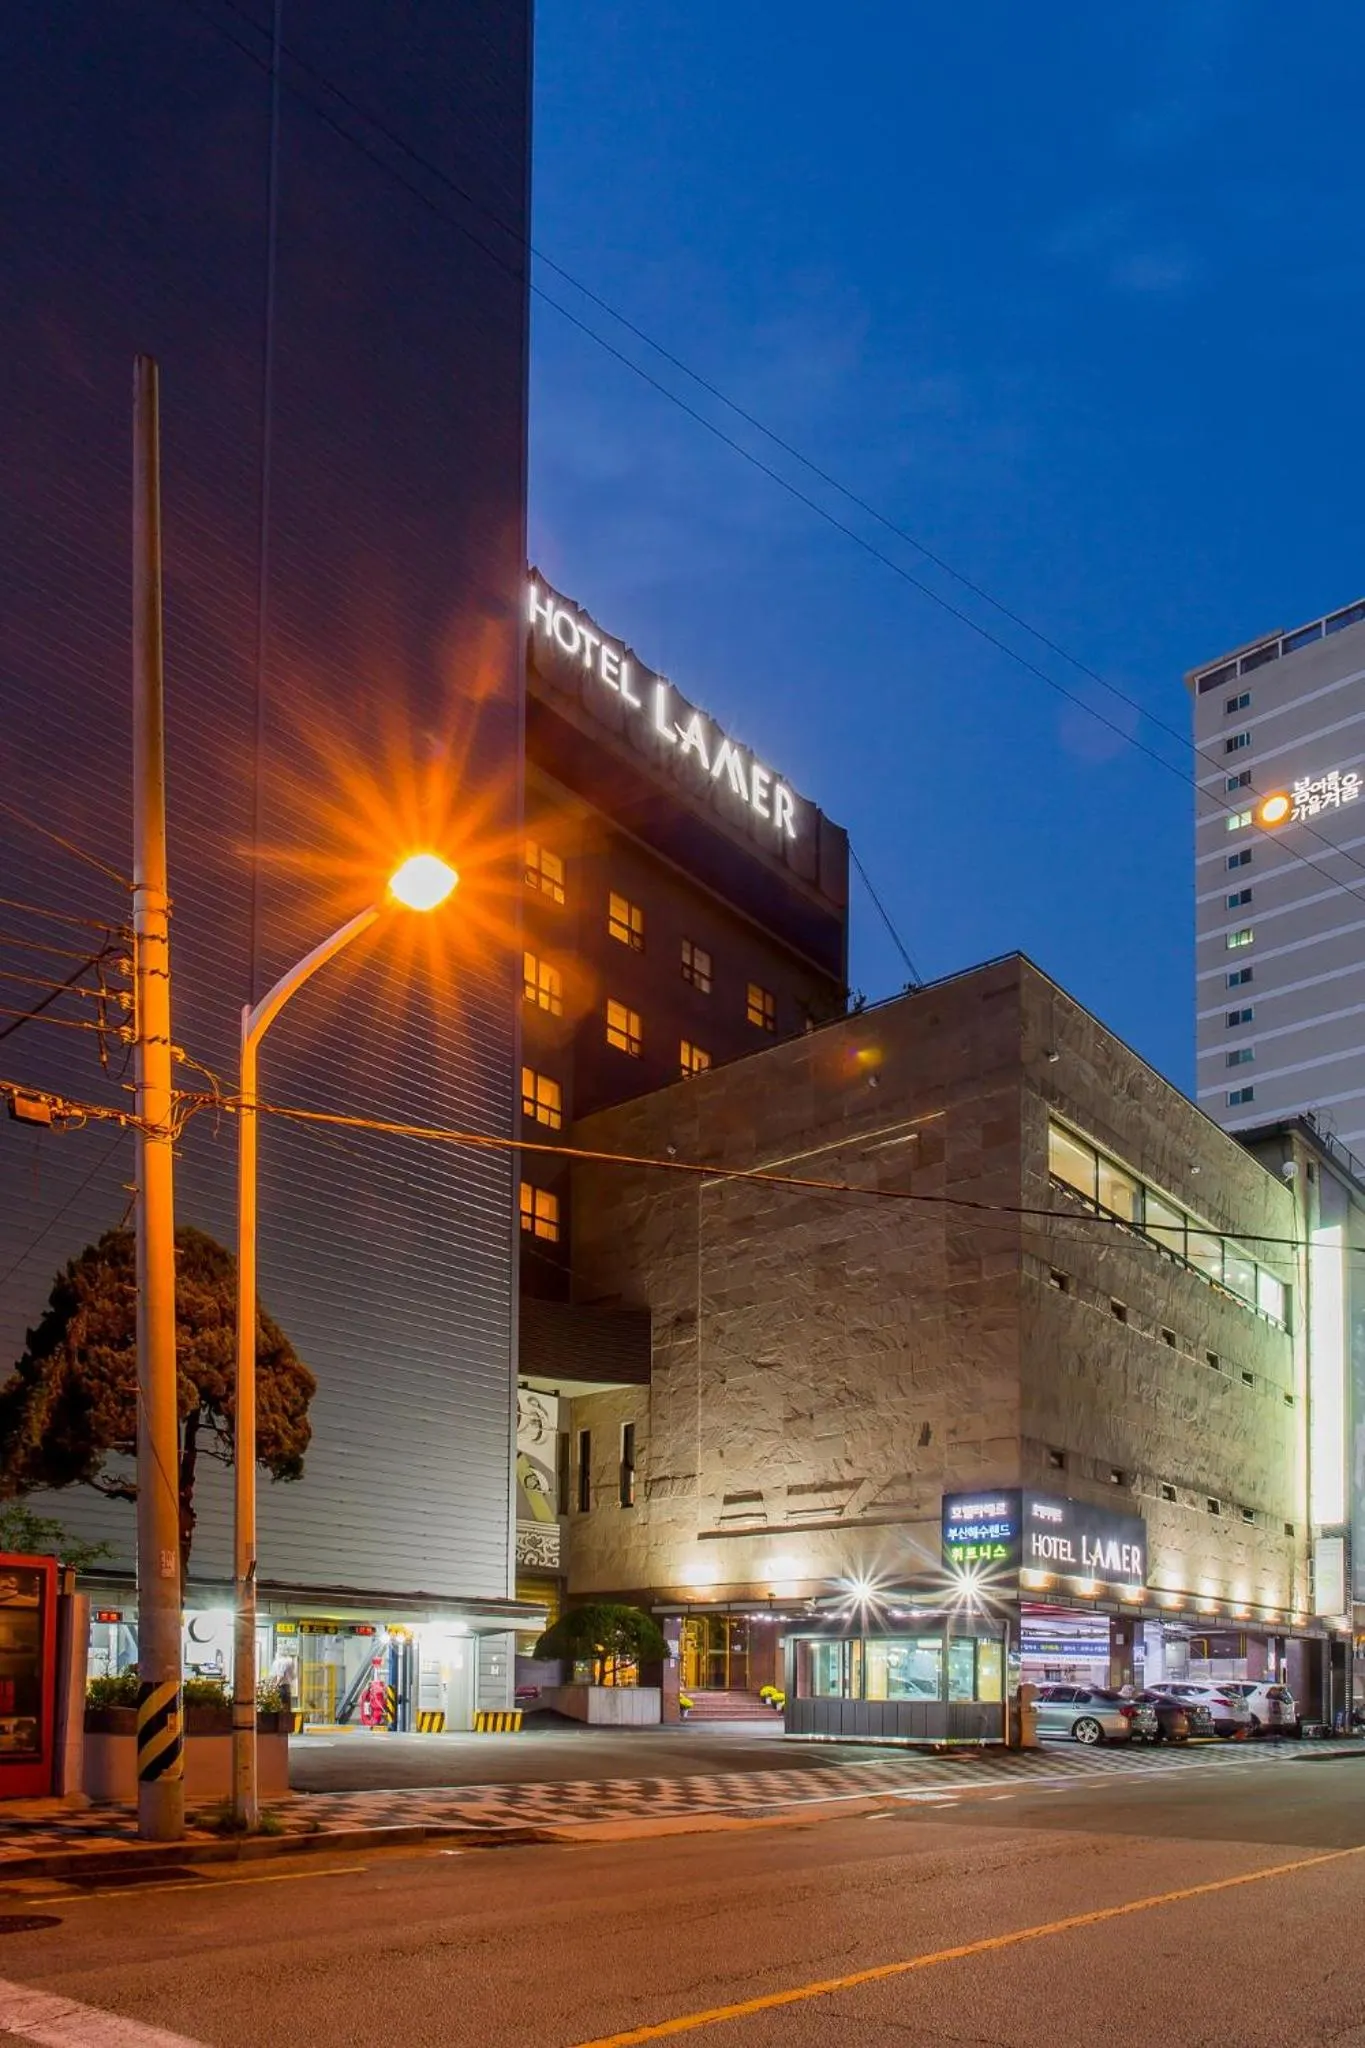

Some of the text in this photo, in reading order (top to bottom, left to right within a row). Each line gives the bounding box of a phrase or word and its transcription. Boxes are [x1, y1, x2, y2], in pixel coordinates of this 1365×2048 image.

[529, 585, 796, 840] HOTEL LAMER
[1032, 1533, 1142, 1576] HOTEL LAMER
